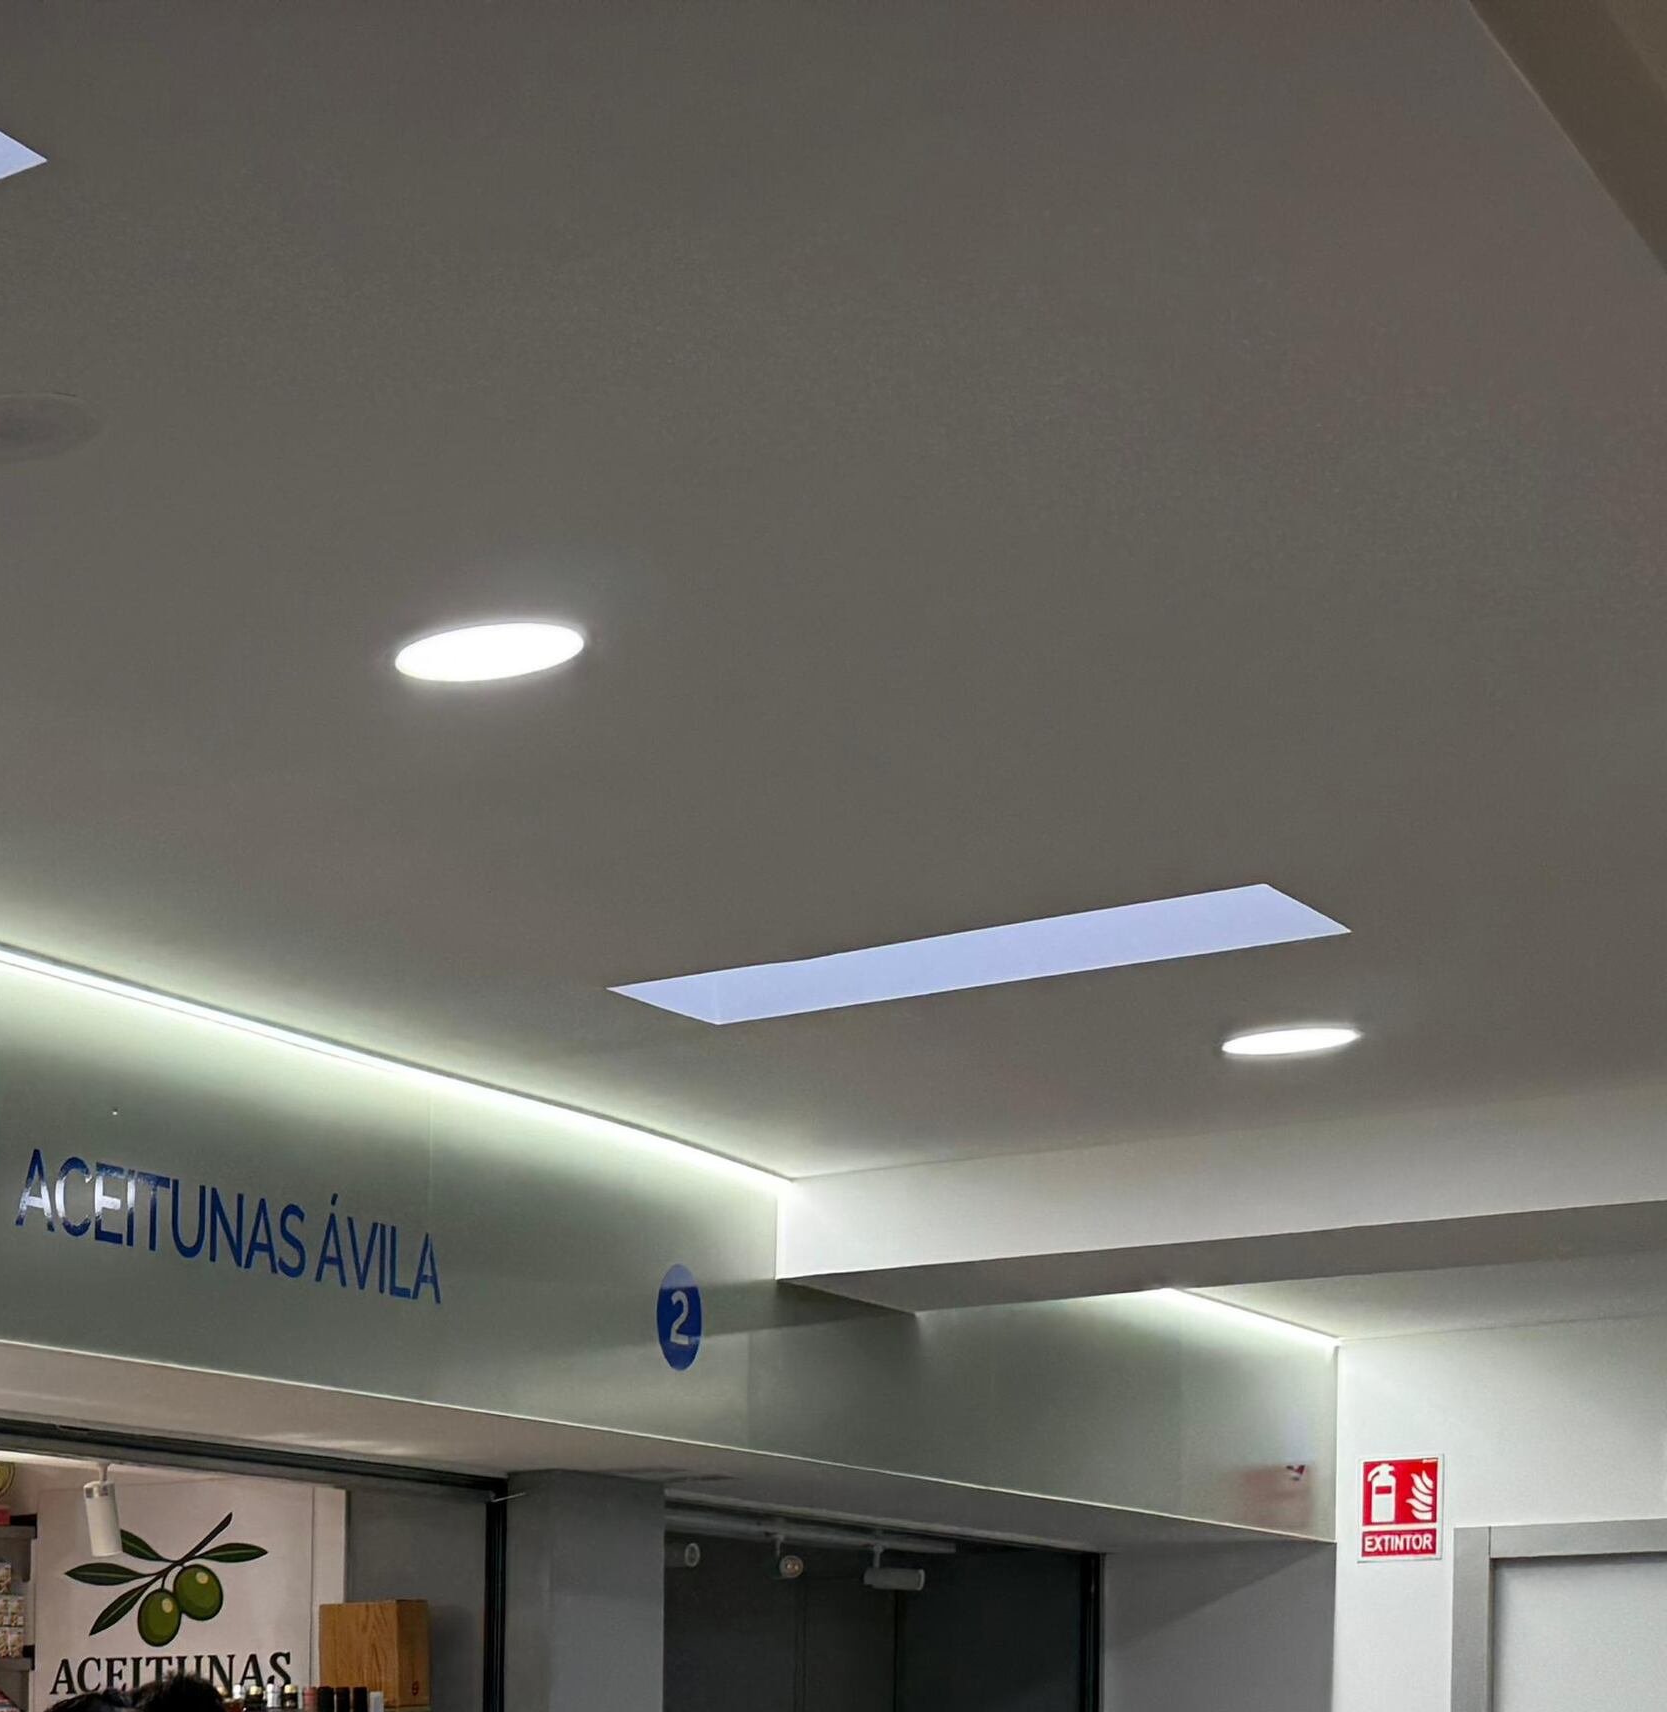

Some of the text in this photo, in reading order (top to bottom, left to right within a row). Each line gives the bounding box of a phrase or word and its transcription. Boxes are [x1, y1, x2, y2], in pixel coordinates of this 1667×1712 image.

[14, 1149, 441, 1304] ACEITUNAS ÁVILA
[670, 1290, 689, 1345] 2
[1364, 1533, 1433, 1553] EXTINTOR
